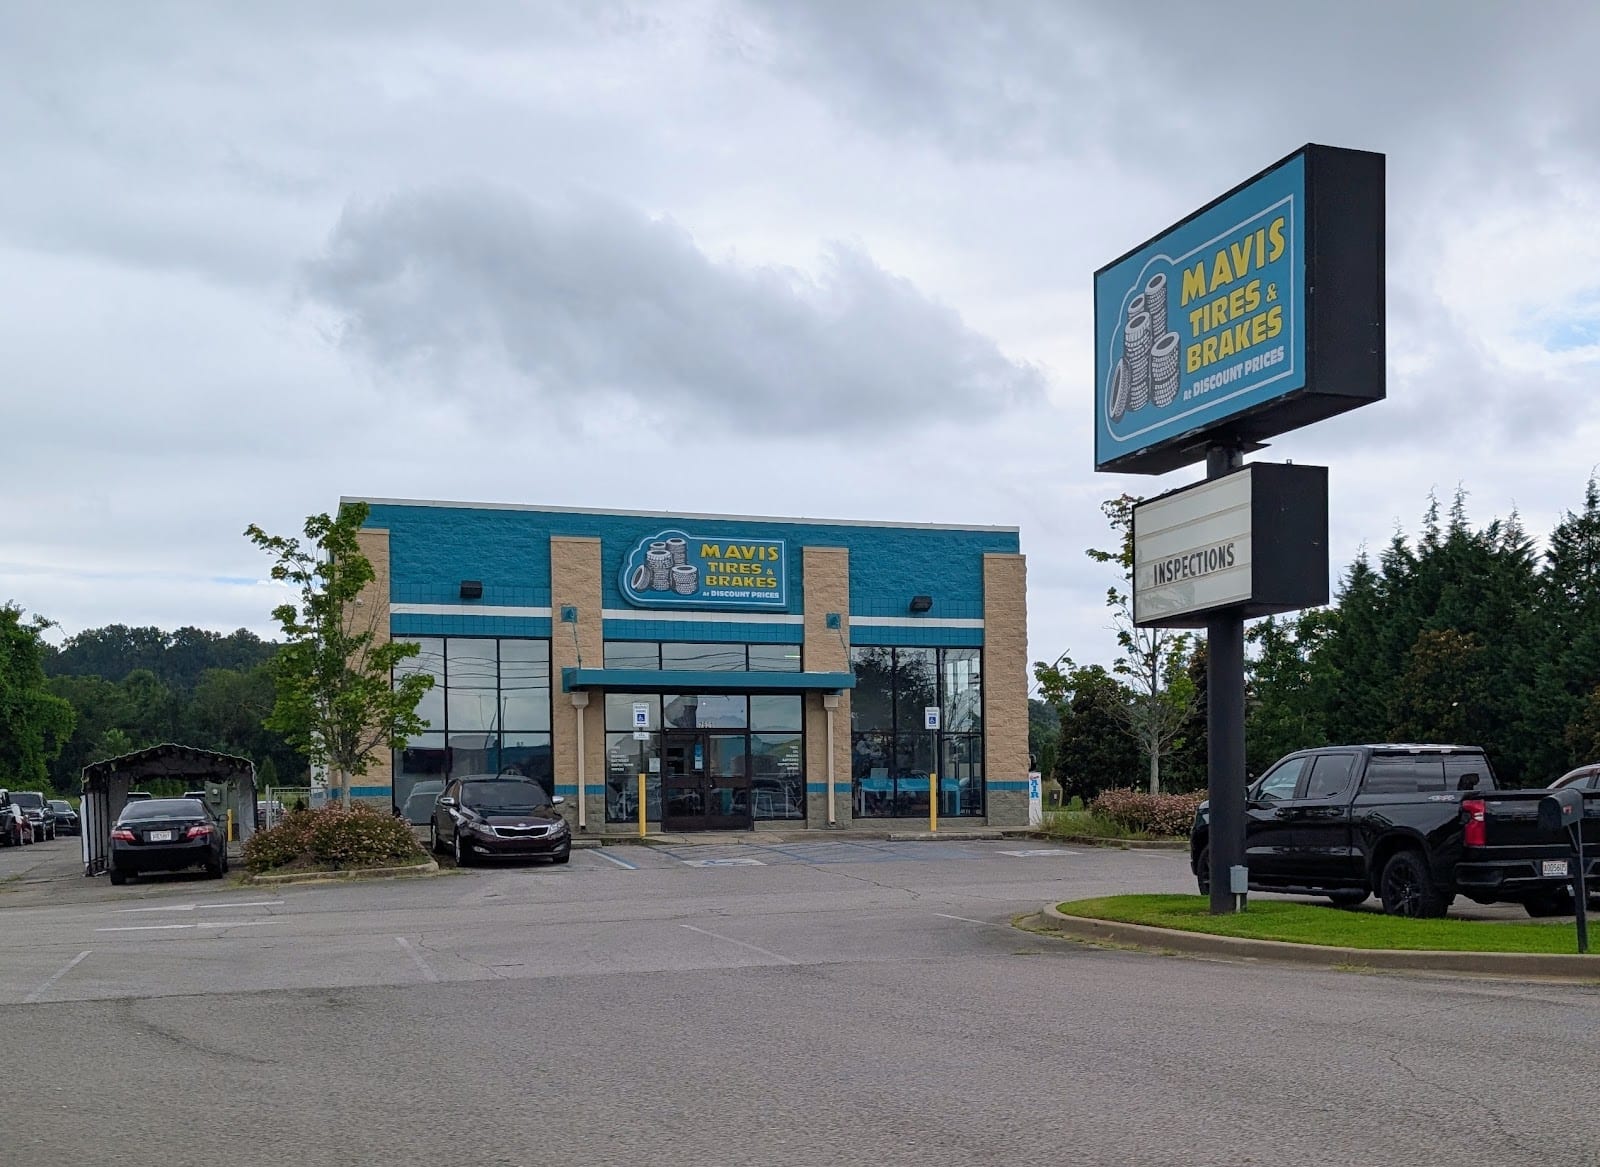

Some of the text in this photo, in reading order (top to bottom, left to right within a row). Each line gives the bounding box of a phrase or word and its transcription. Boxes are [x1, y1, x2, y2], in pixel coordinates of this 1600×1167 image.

[1181, 216, 1286, 307] MAVIS
[1189, 279, 1278, 337] TIRES &
[1186, 306, 1283, 374] BRAKES
[1193, 363, 1243, 397] DISCOUNT
[1244, 345, 1285, 376] PRICES
[700, 543, 779, 561] MAVIS
[707, 562, 774, 576] TIRES &
[1153, 542, 1235, 585] INSPECTIONS
[705, 575, 778, 588] BRAKES
[710, 590, 750, 598] DISCOUNT
[751, 591, 780, 599] PRICES
